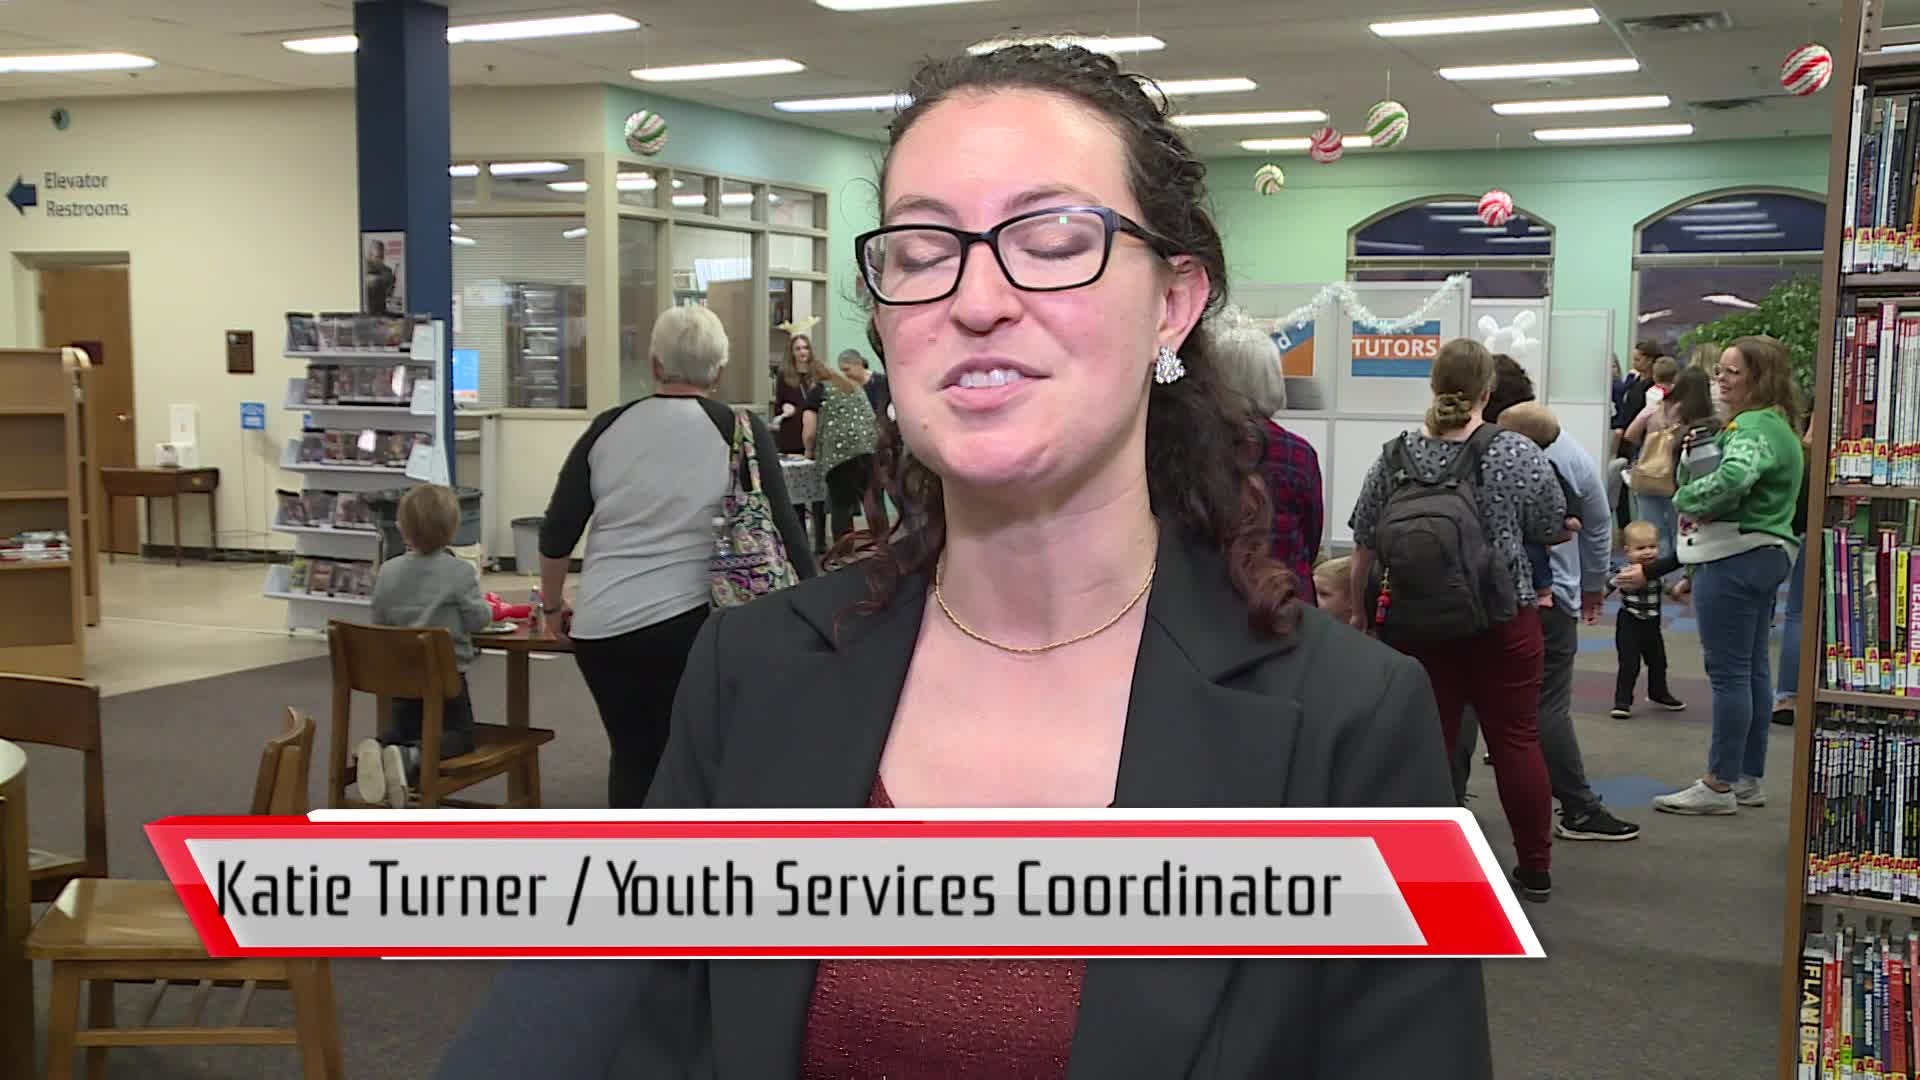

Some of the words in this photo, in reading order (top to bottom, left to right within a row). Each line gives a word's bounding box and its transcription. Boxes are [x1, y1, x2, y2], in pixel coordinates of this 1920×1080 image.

[44, 172, 109, 189] Elevator
[46, 200, 129, 217] Restrooms
[1352, 338, 1438, 358] TUTORS
